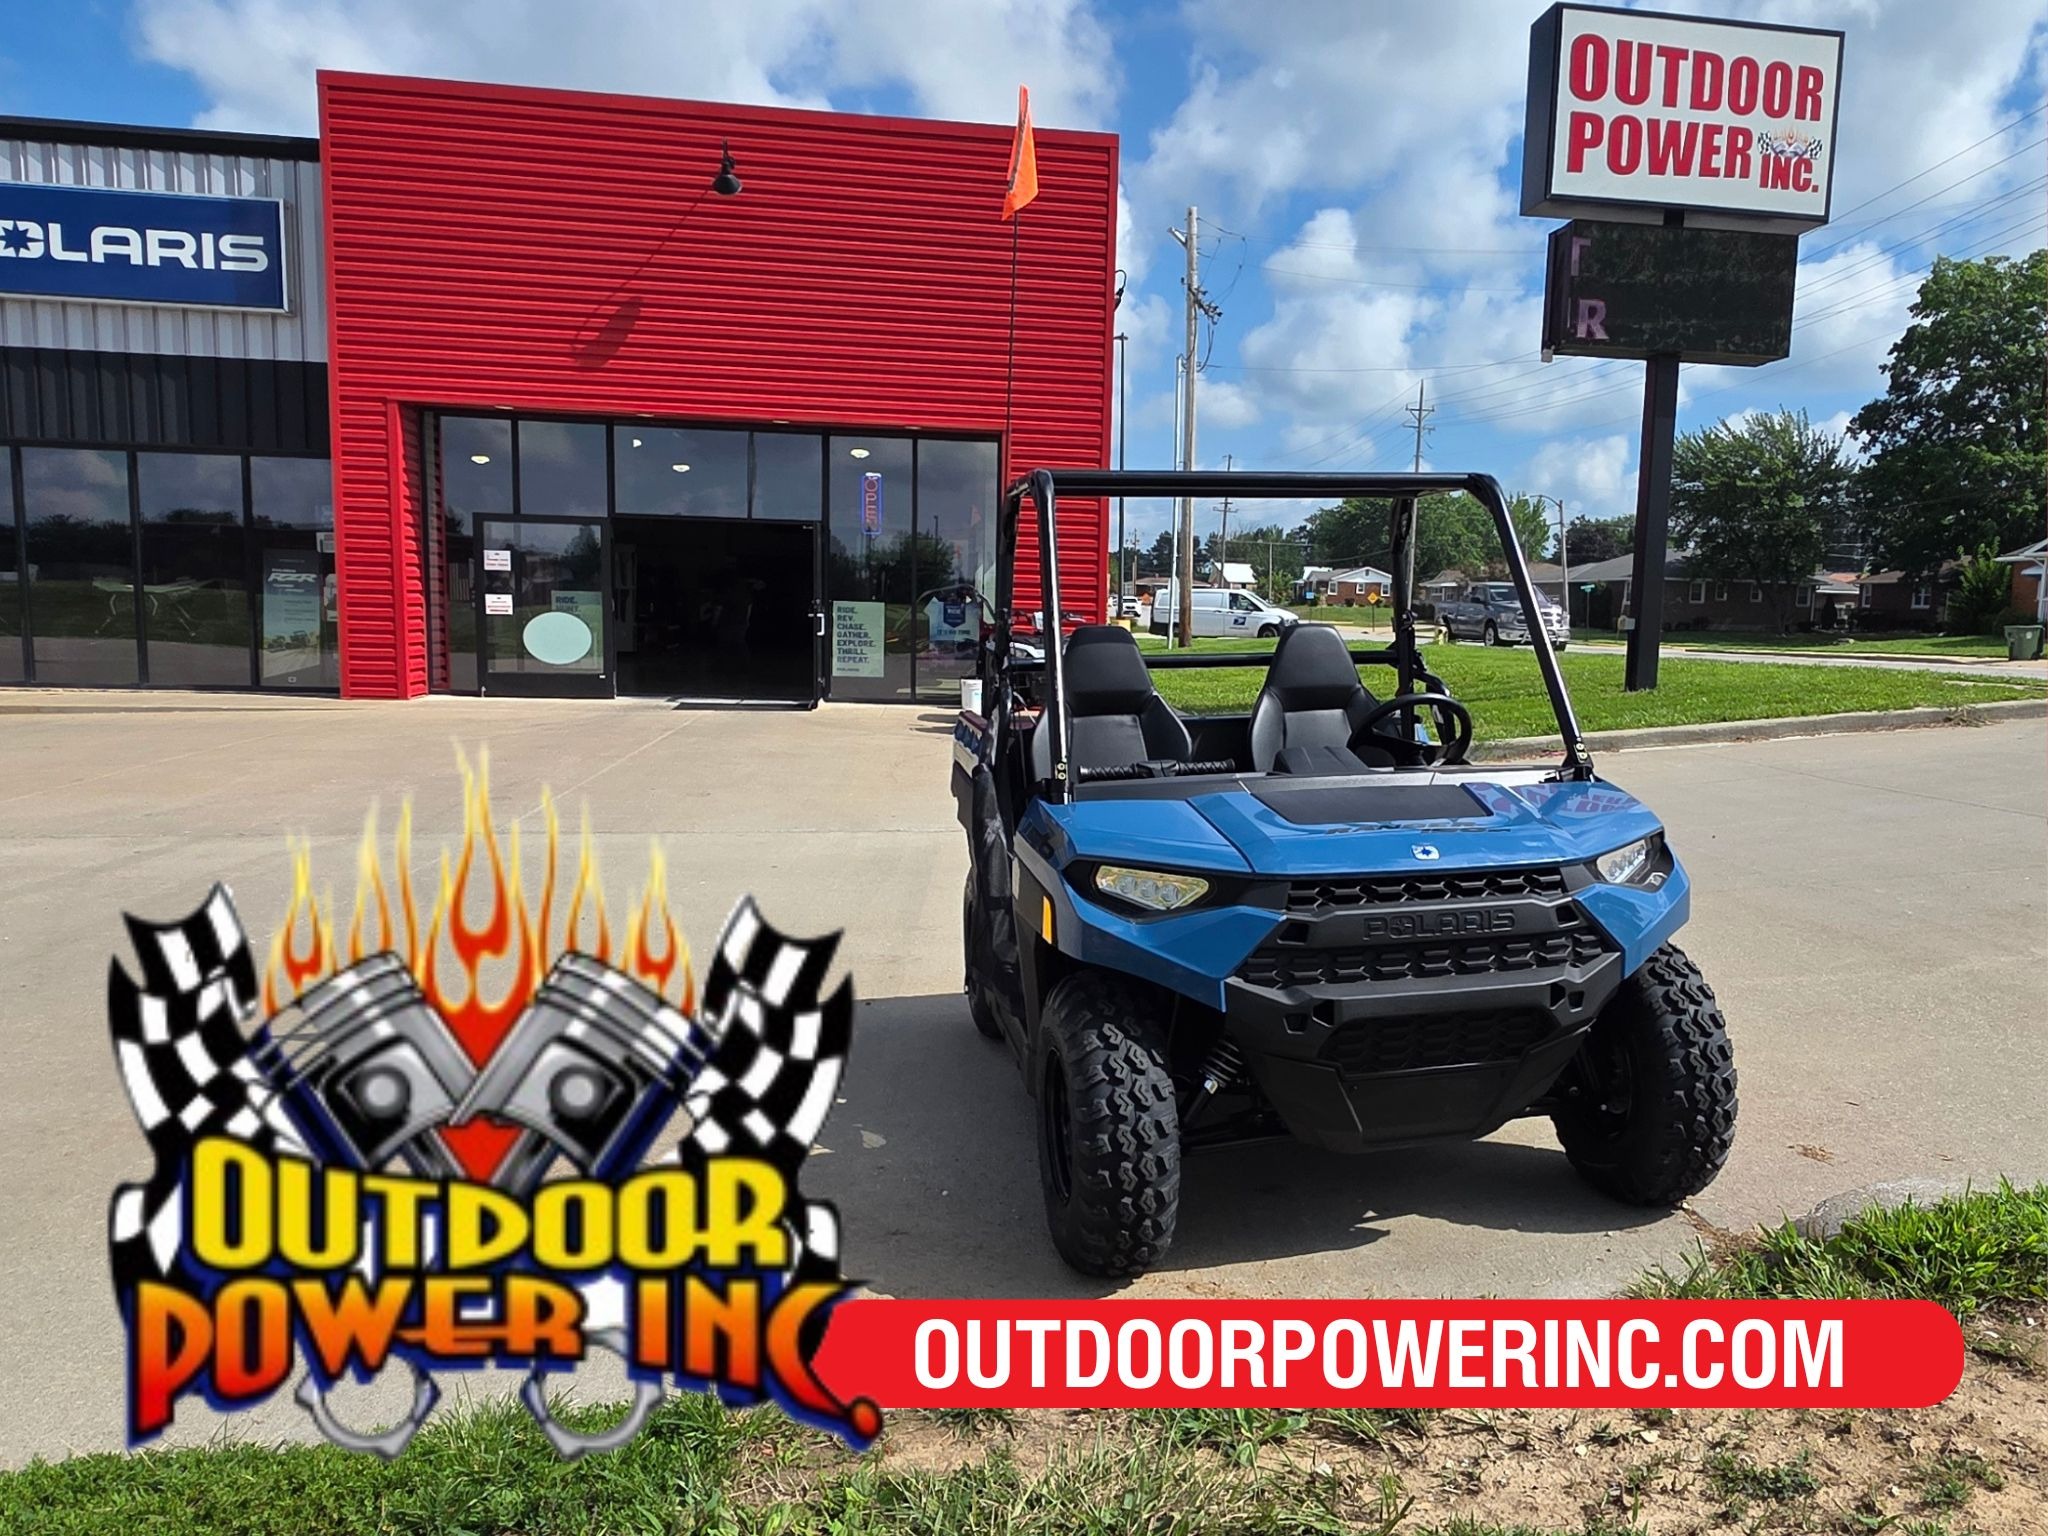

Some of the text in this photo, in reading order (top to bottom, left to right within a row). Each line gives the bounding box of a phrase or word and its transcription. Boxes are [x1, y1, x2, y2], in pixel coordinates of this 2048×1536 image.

[1568, 33, 1824, 122] OUTDOOR
[1566, 111, 1820, 193] POWER INC.
[1363, 908, 1515, 940] POLARIS
